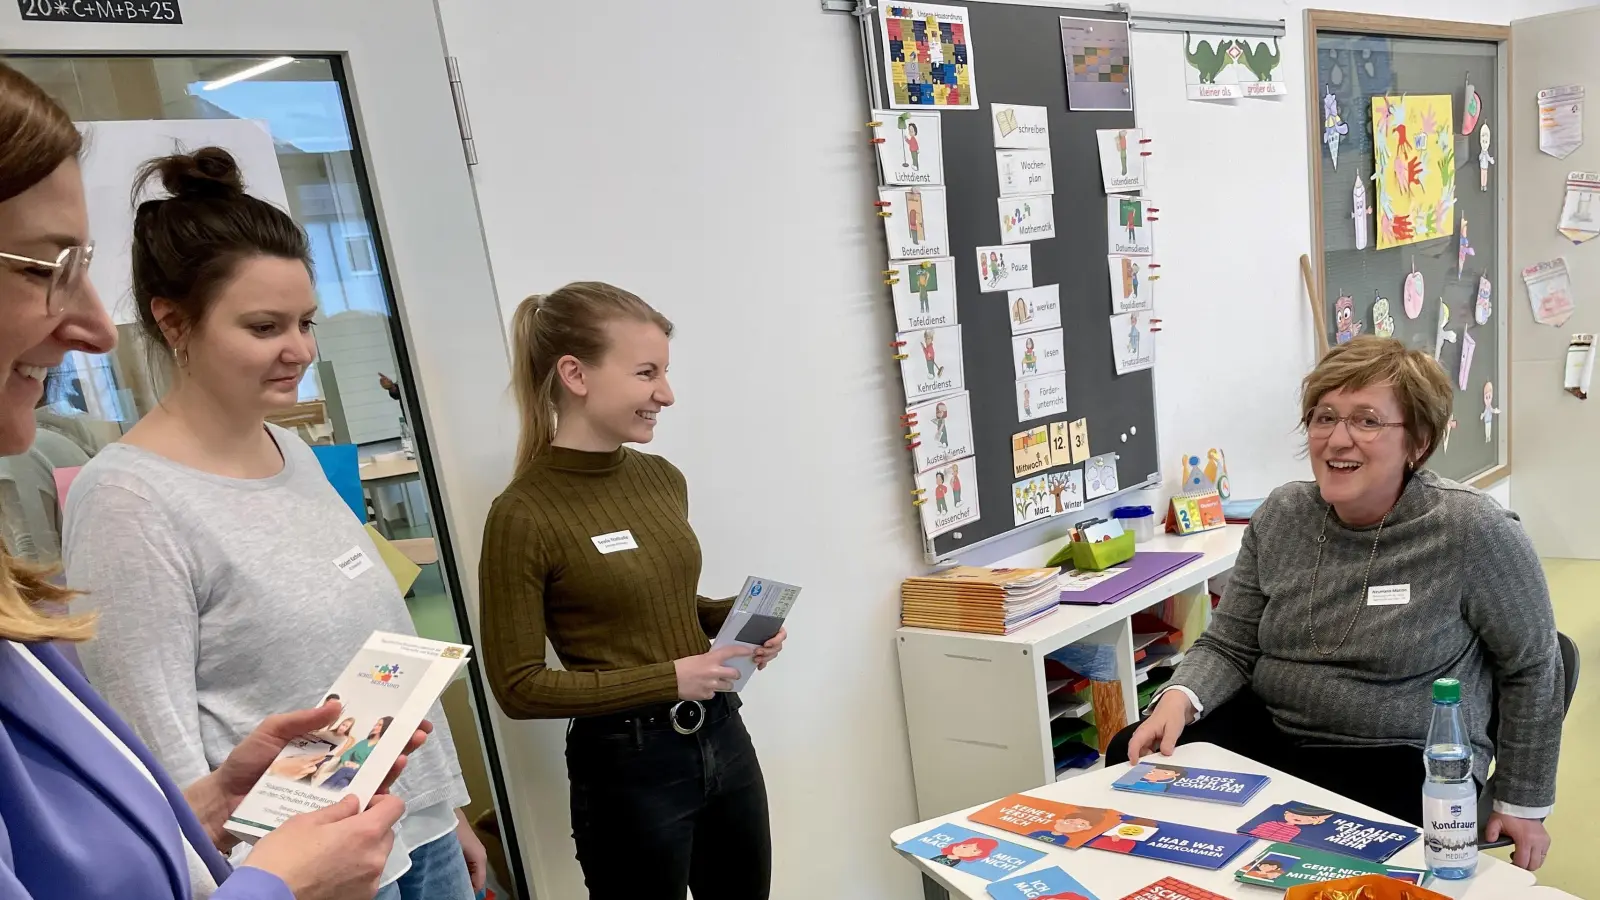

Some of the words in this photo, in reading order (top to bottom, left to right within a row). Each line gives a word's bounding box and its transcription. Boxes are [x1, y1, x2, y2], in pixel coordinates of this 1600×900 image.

[1199, 86, 1220, 97] kleiner
[1221, 86, 1232, 97] als
[1247, 83, 1266, 96] größer
[1266, 84, 1276, 93] als
[1018, 124, 1046, 134] schreiben
[1020, 160, 1046, 170] Wochen-
[895, 172, 931, 183] Lichtdienst
[1028, 173, 1042, 185] plan
[1019, 221, 1053, 234] Mathematik
[901, 245, 940, 257] Botendienst
[1115, 243, 1149, 253] Datumsdienst
[1011, 262, 1028, 272] Pause
[1036, 302, 1056, 311] werken
[908, 315, 946, 327] Tafeldienst
[1044, 348, 1059, 358] lesen
[917, 380, 952, 392] Kehrdienst
[1039, 386, 1060, 396] Förder-
[1036, 396, 1064, 409] unterricht
[1053, 437, 1066, 450] 12.
[926, 446, 967, 466] Austeildienst
[1015, 460, 1043, 474] Mittwoch
[1034, 505, 1050, 516] März
[1063, 500, 1082, 510] Winter
[934, 507, 970, 528] Klassenchef
[1177, 777, 1218, 787] NOCH
[1219, 782, 1245, 791] AM
[1196, 774, 1236, 784] BLOSS
[1172, 781, 1242, 794] COMPUTER
[279, 794, 303, 806] Schulen
[304, 799, 310, 807] in
[310, 801, 322, 811] Bay
[998, 815, 1032, 826] MICH
[999, 807, 1053, 824] VERSTEHT
[1332, 818, 1364, 830] HAT
[1365, 827, 1407, 841] ALLES
[1431, 820, 1475, 830] Kondrauer
[932, 833, 955, 843] ICH
[1335, 825, 1390, 843] KEINEN
[1336, 832, 1372, 846] SINN
[918, 836, 948, 848] MAG
[1158, 836, 1189, 846] HAB
[1192, 841, 1225, 852] WAS
[1323, 835, 1367, 850] MEHR
[1146, 841, 1224, 858] ABBEKOMMEN
[992, 852, 1027, 866] MICH
[1445, 852, 1469, 860] MEDIUM
[981, 856, 1020, 872] NICHT
[1301, 863, 1337, 872] GEHT
[1286, 871, 1332, 882] MITEIN
[1013, 881, 1041, 898] MAG
[1029, 879, 1051, 893] ICH
